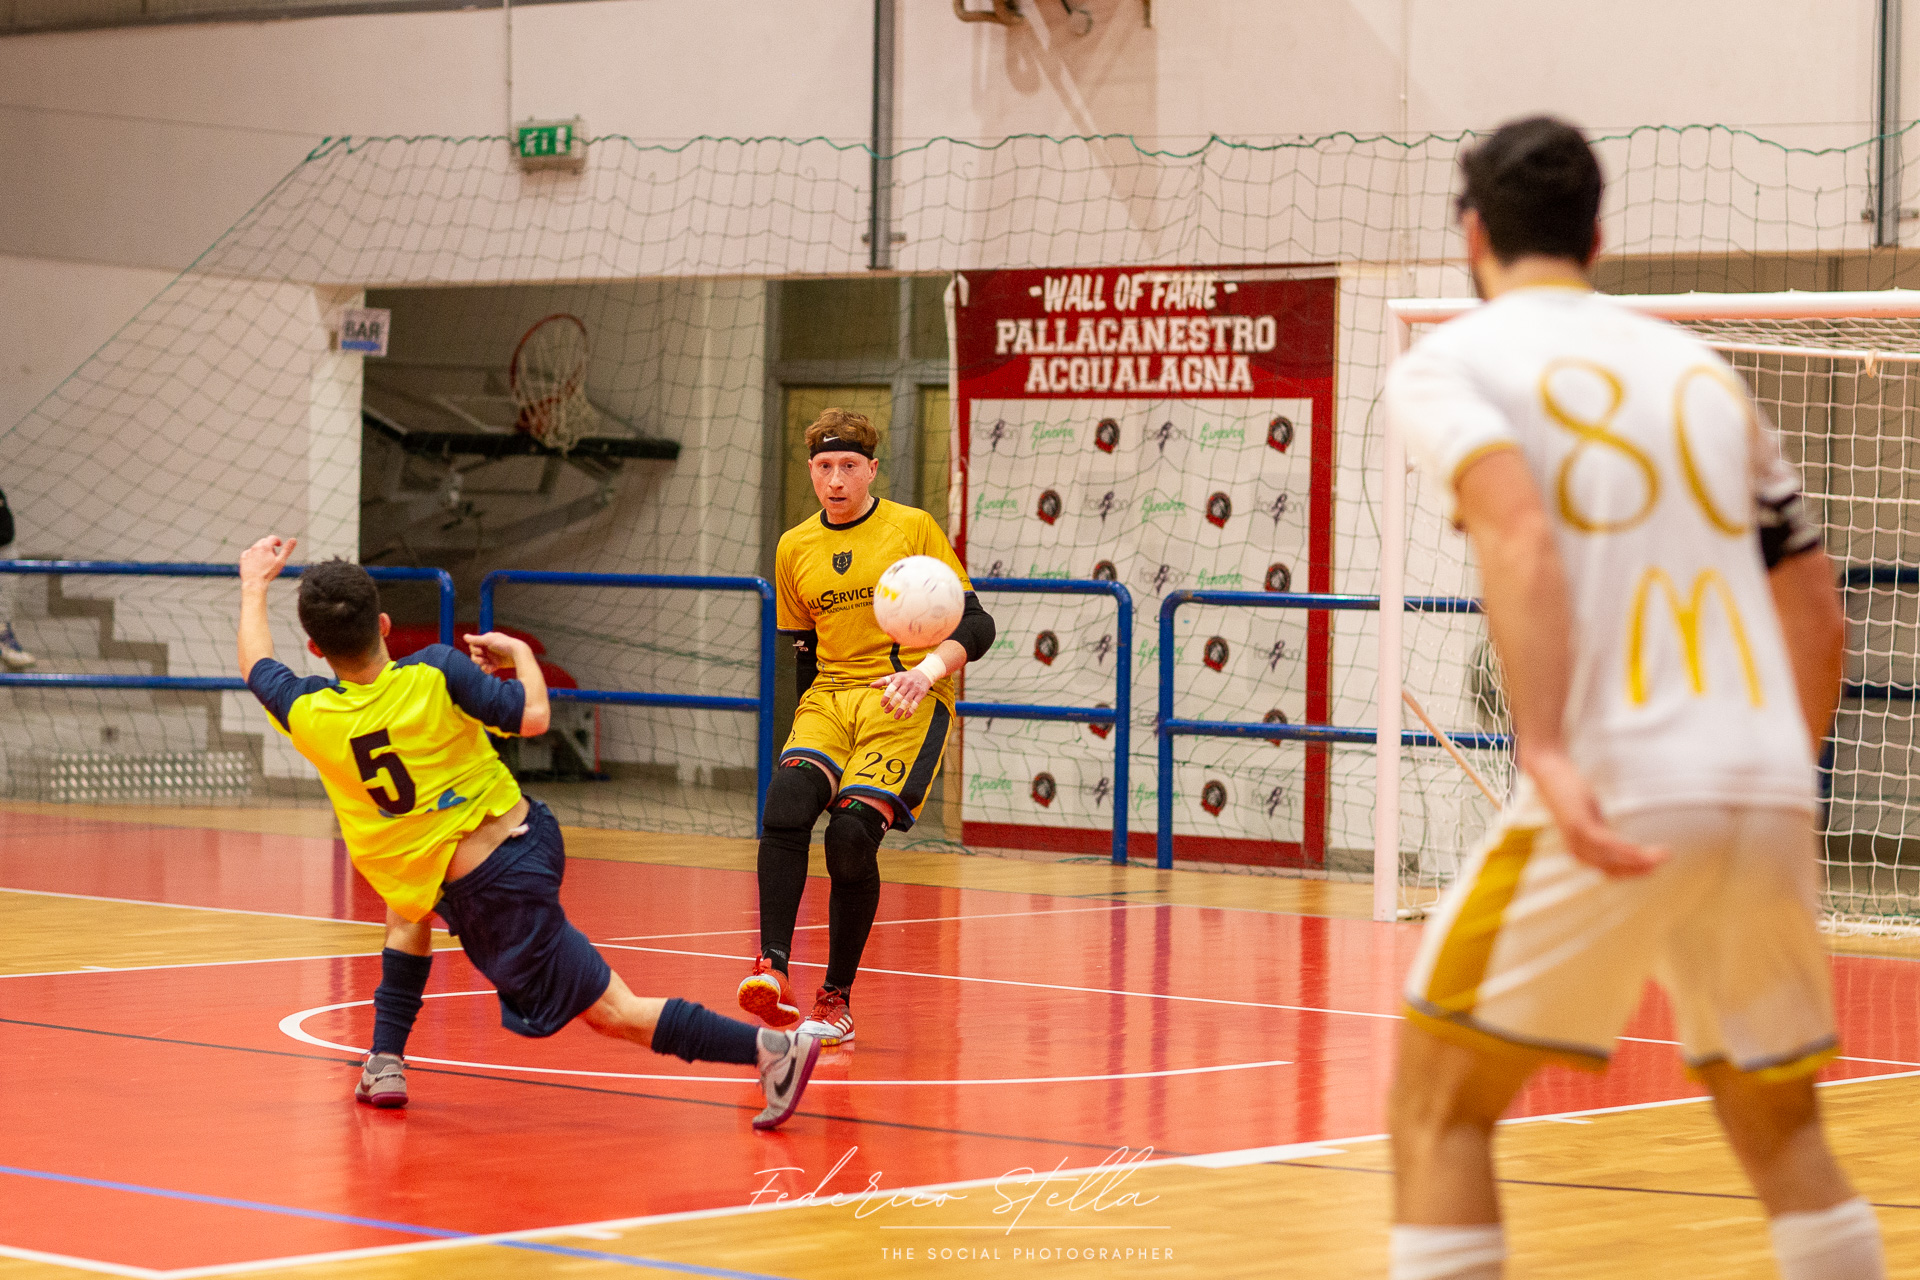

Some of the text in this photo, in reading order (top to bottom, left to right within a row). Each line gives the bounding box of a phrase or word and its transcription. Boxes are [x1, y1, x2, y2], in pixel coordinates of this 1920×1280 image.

[1114, 272, 1148, 312] OF
[344, 320, 381, 339] BAR
[995, 315, 1278, 355] PALLACANESTRO
[1024, 355, 1255, 393] ACQUALAGNA
[1539, 356, 1758, 538] 80
[854, 599, 875, 609] INTERN
[350, 728, 416, 815] 5
[855, 752, 906, 786] 29
